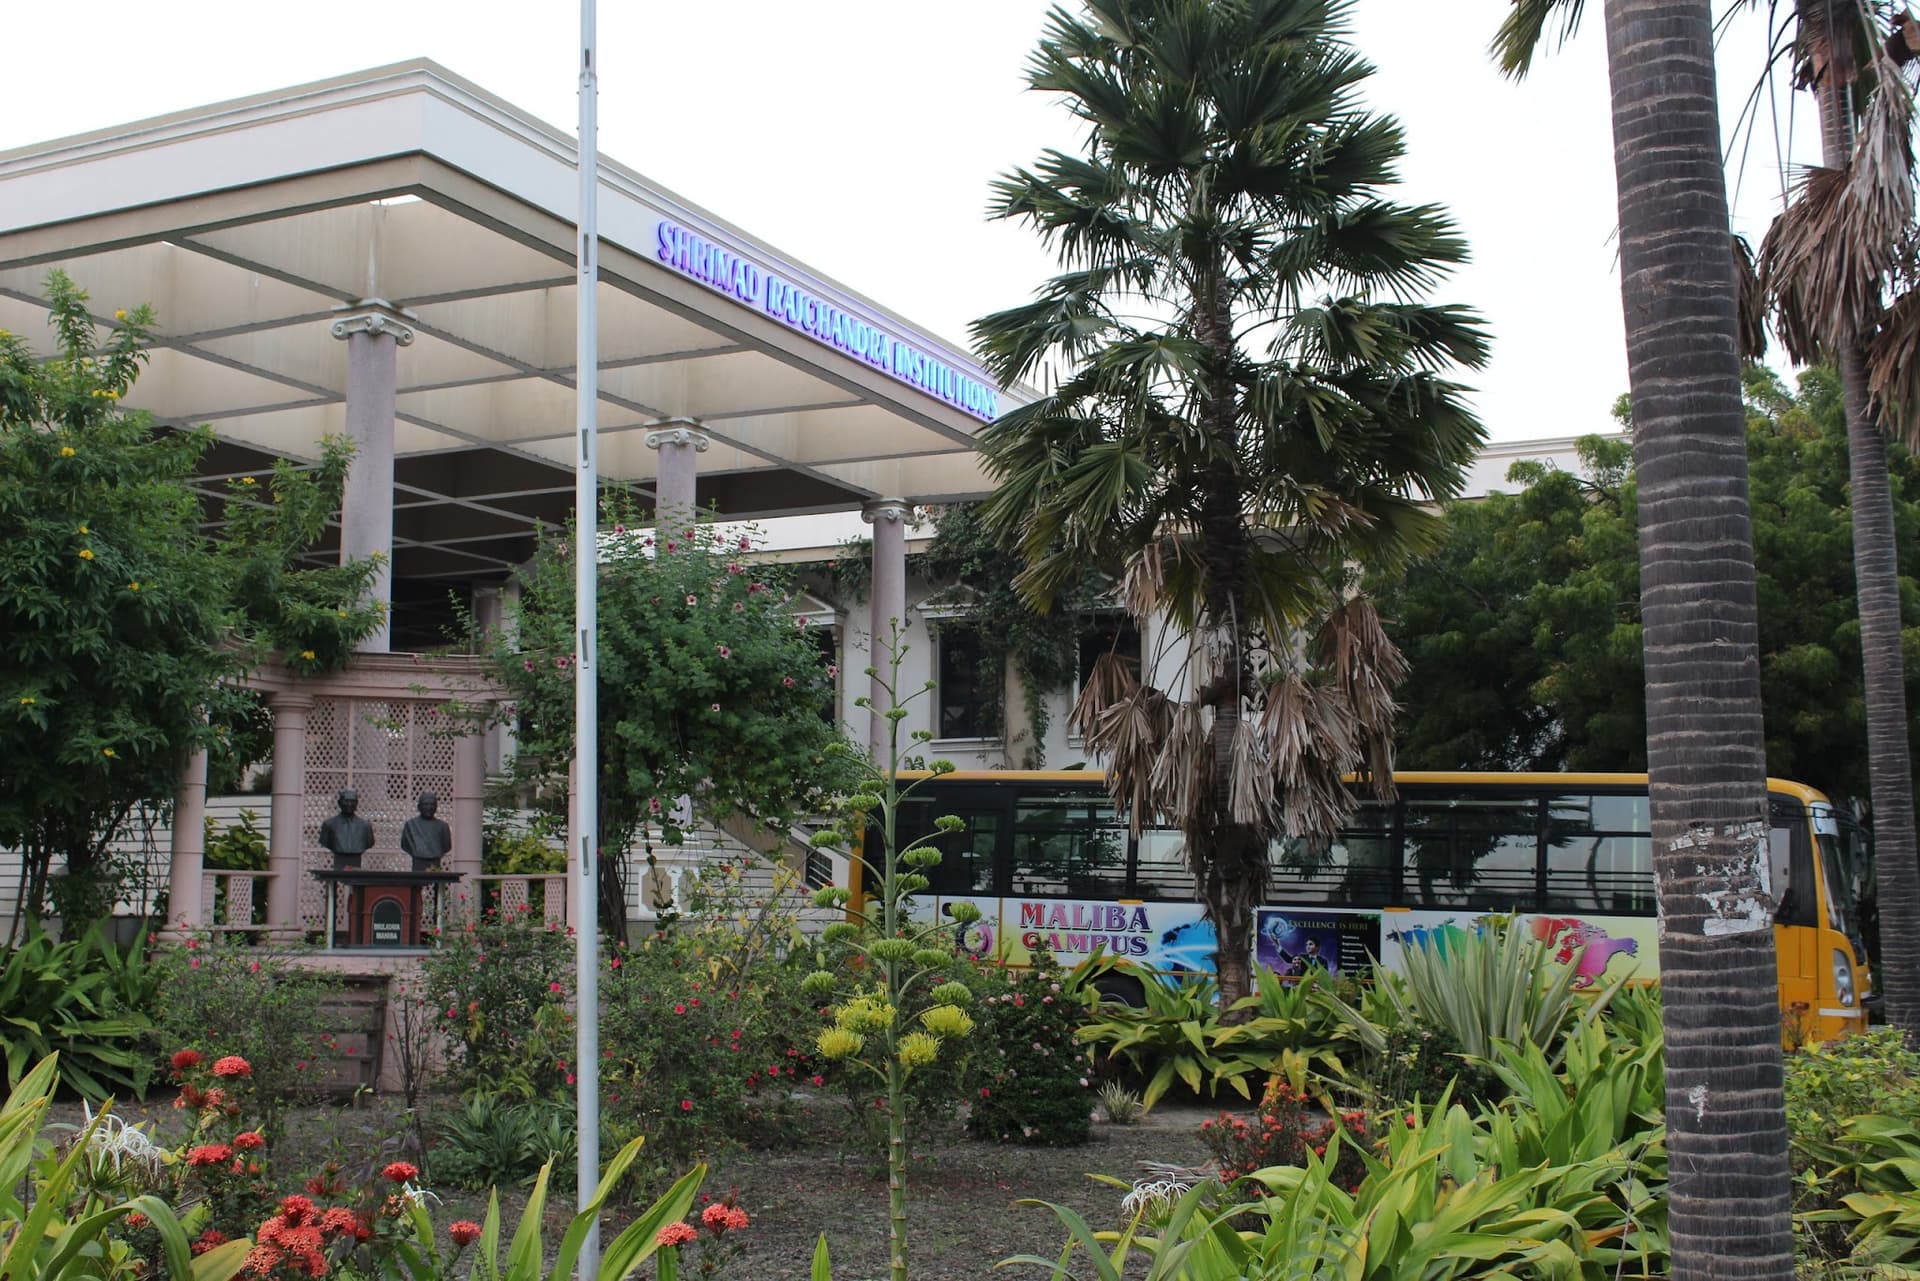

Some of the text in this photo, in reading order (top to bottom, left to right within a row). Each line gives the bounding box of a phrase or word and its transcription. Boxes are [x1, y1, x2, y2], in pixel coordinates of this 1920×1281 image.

[658, 221, 760, 303] SHRIMAD
[893, 341, 999, 421] INSTITUTIONS
[1020, 902, 1153, 932] MALIBA
[1288, 920, 1336, 929] EXCELLENCE
[1023, 932, 1150, 956] CAMPUS
